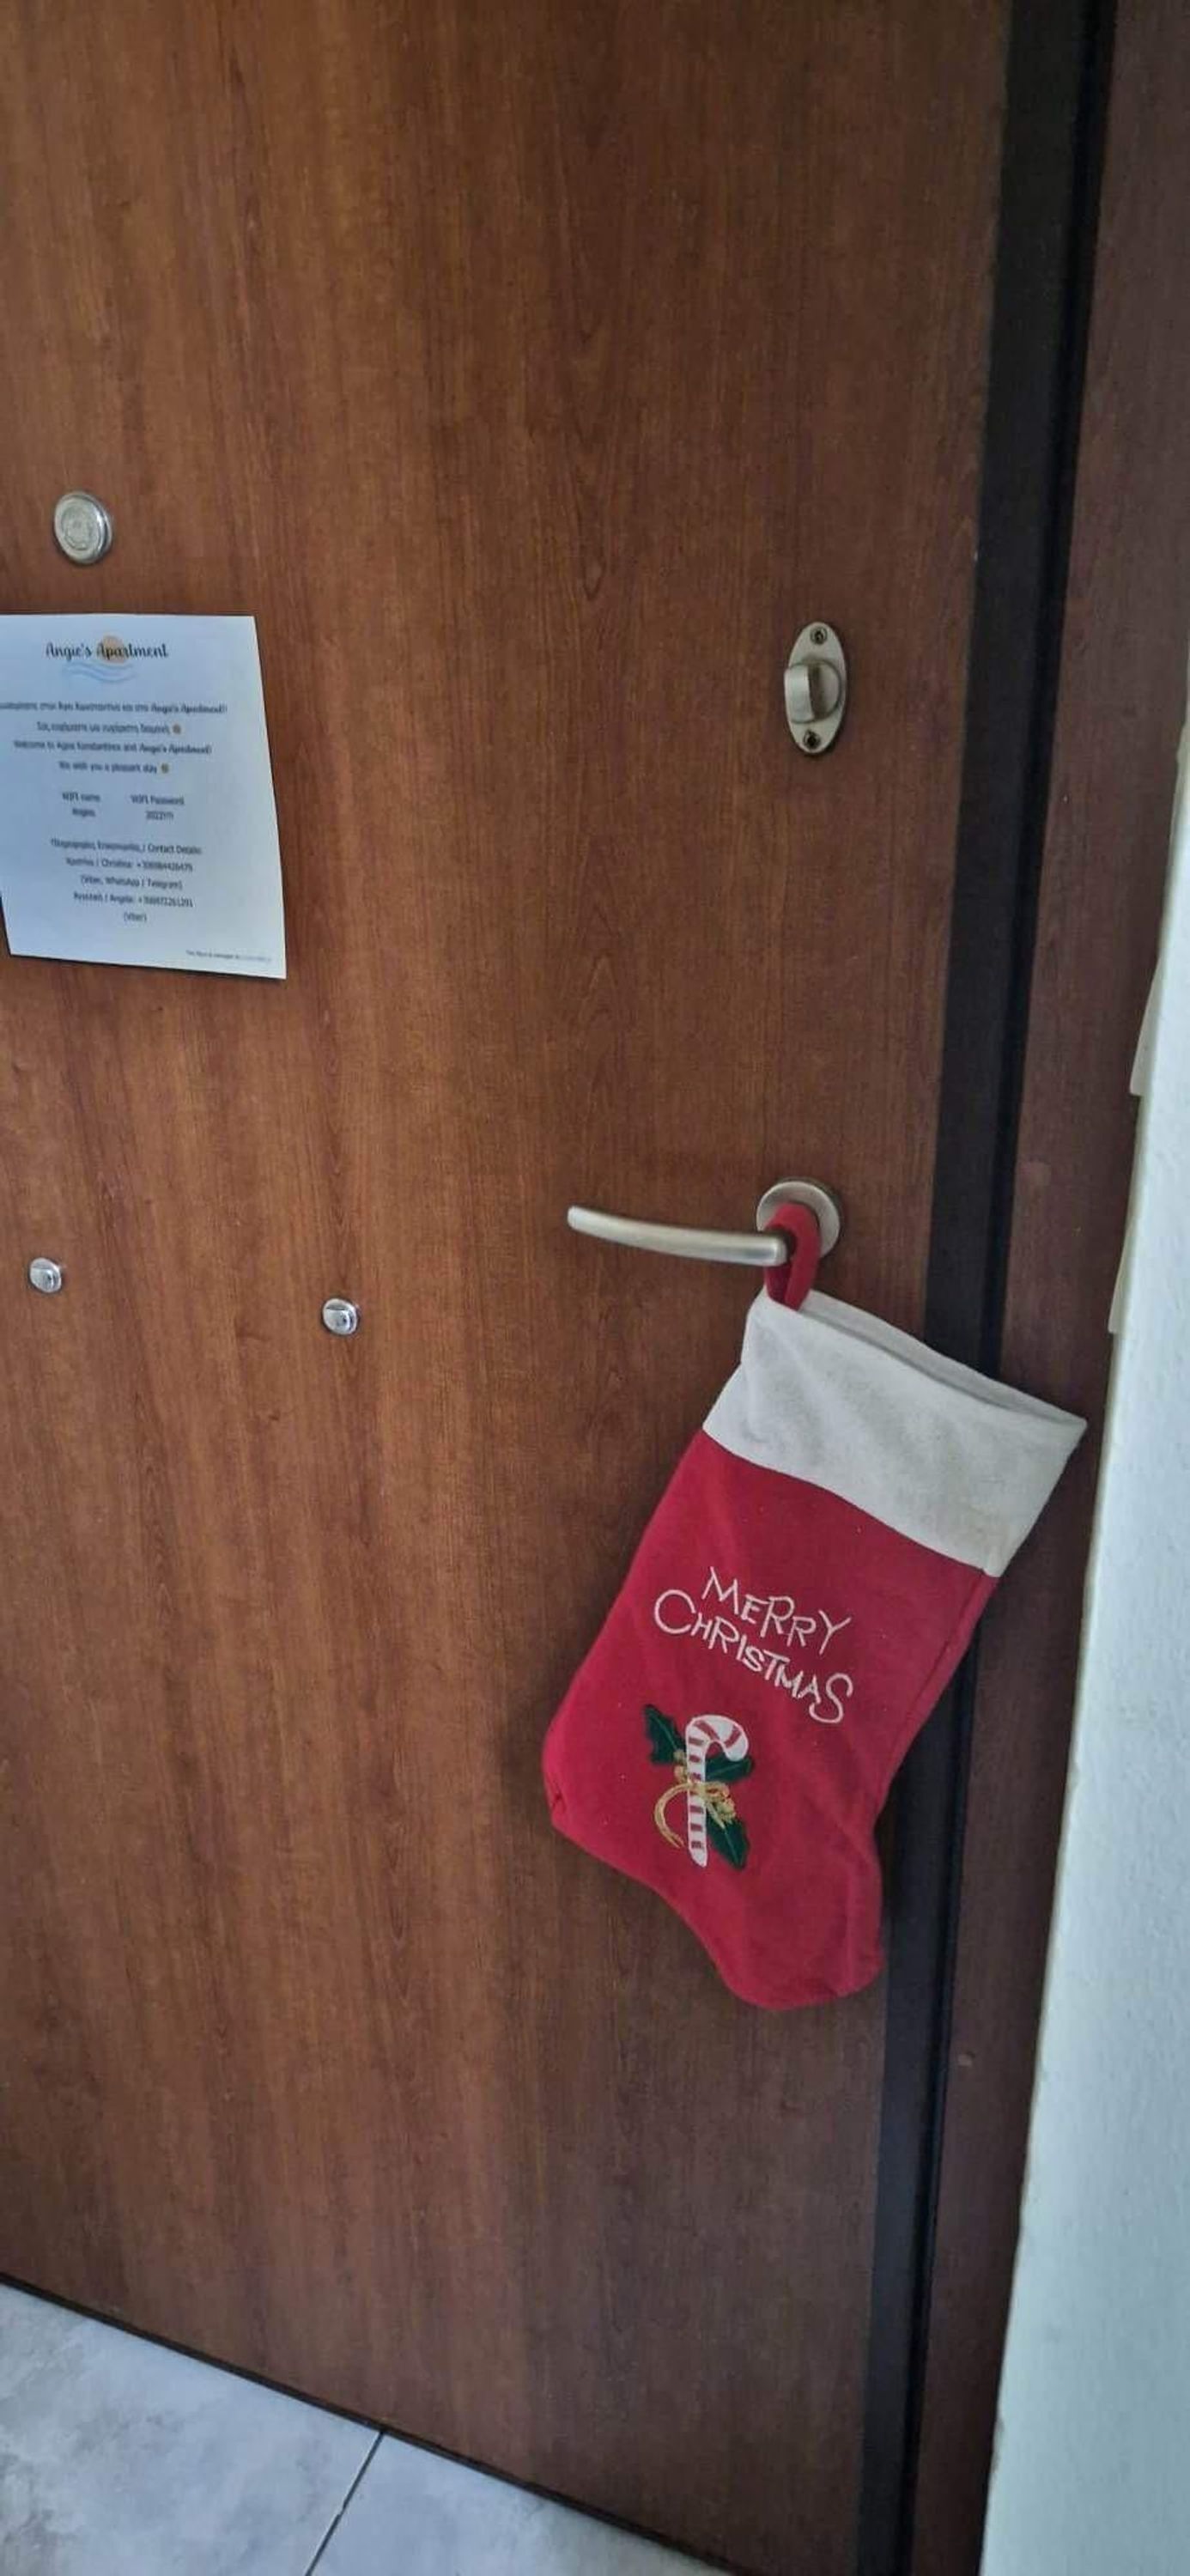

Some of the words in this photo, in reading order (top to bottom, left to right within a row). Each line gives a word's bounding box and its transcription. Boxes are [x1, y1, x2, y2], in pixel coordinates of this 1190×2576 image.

[46, 641, 92, 661] Angie's
[96, 642, 169, 660] Apartment
[701, 1565, 852, 1655] MERRY
[653, 1589, 853, 1725] CHRISTMAS
